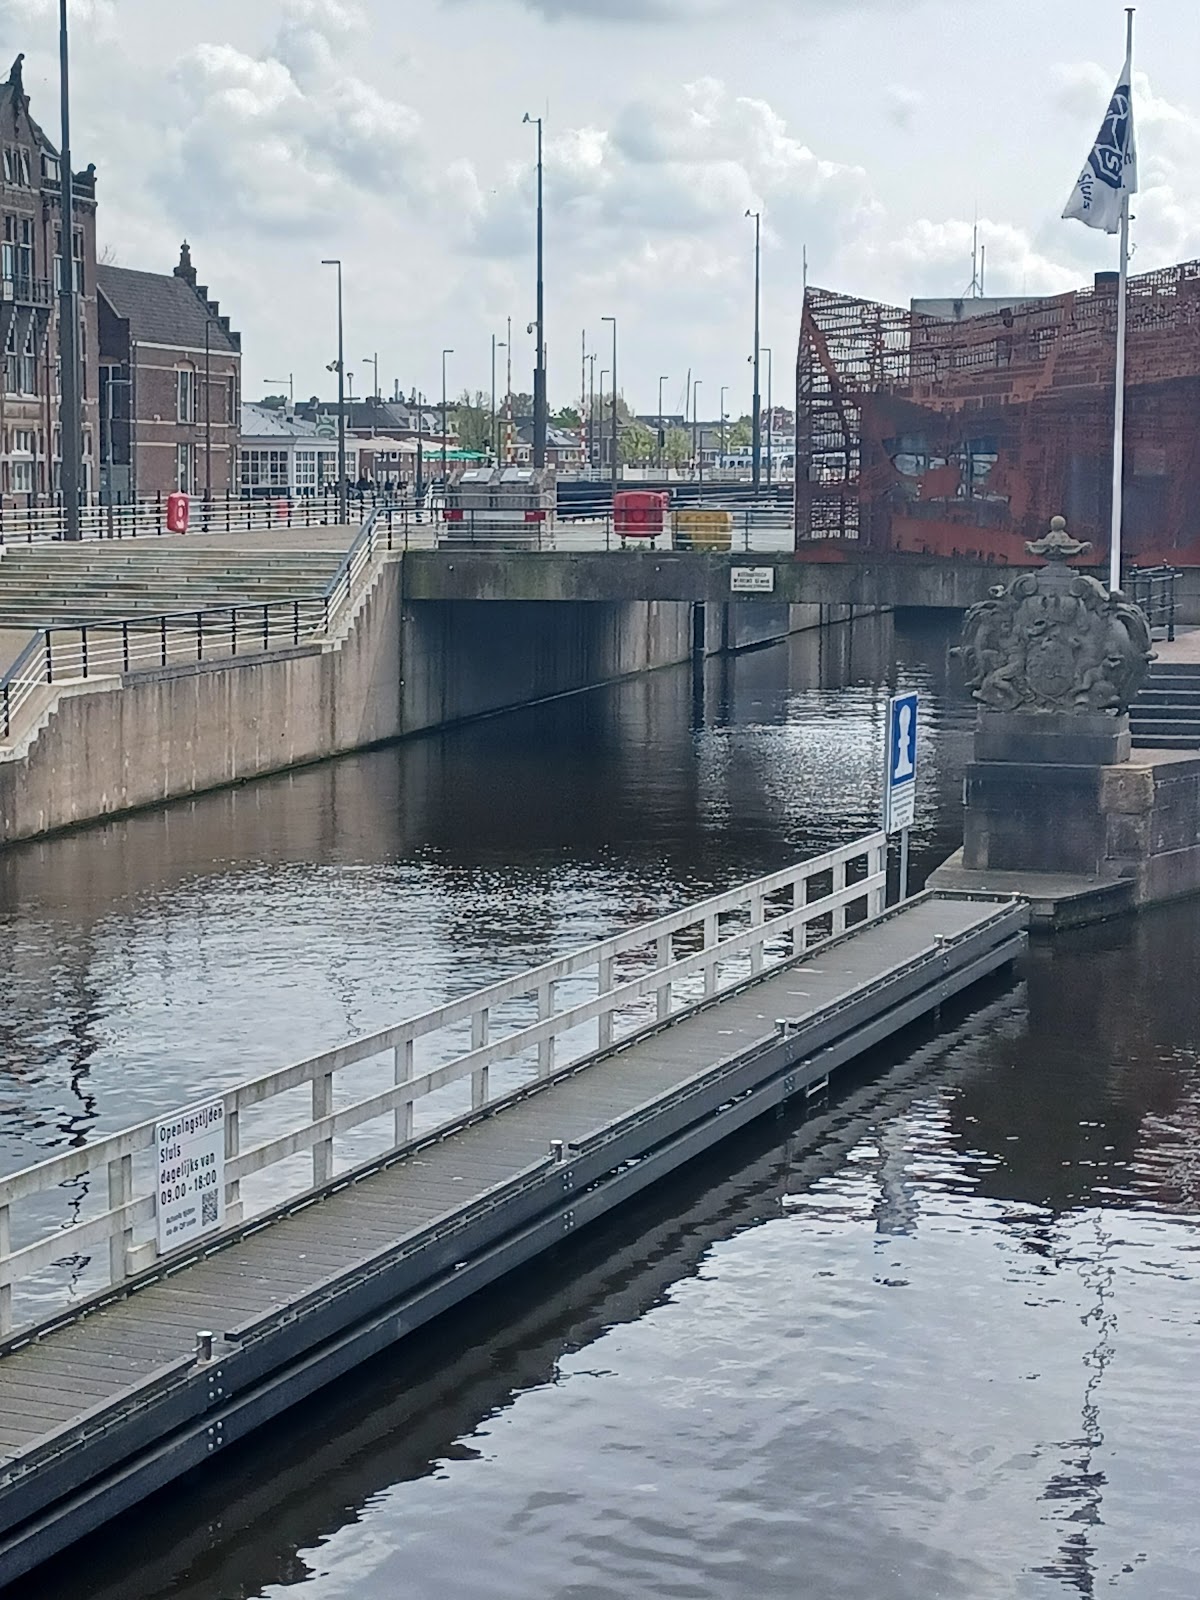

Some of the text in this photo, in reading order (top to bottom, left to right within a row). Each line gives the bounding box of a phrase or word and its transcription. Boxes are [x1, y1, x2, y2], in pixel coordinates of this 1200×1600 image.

[160, 1106, 223, 1144] Openingstijden
[160, 1143, 181, 1163] Sluis
[161, 1152, 215, 1184] dagelijks van
[161, 1183, 187, 1206] 09.00
